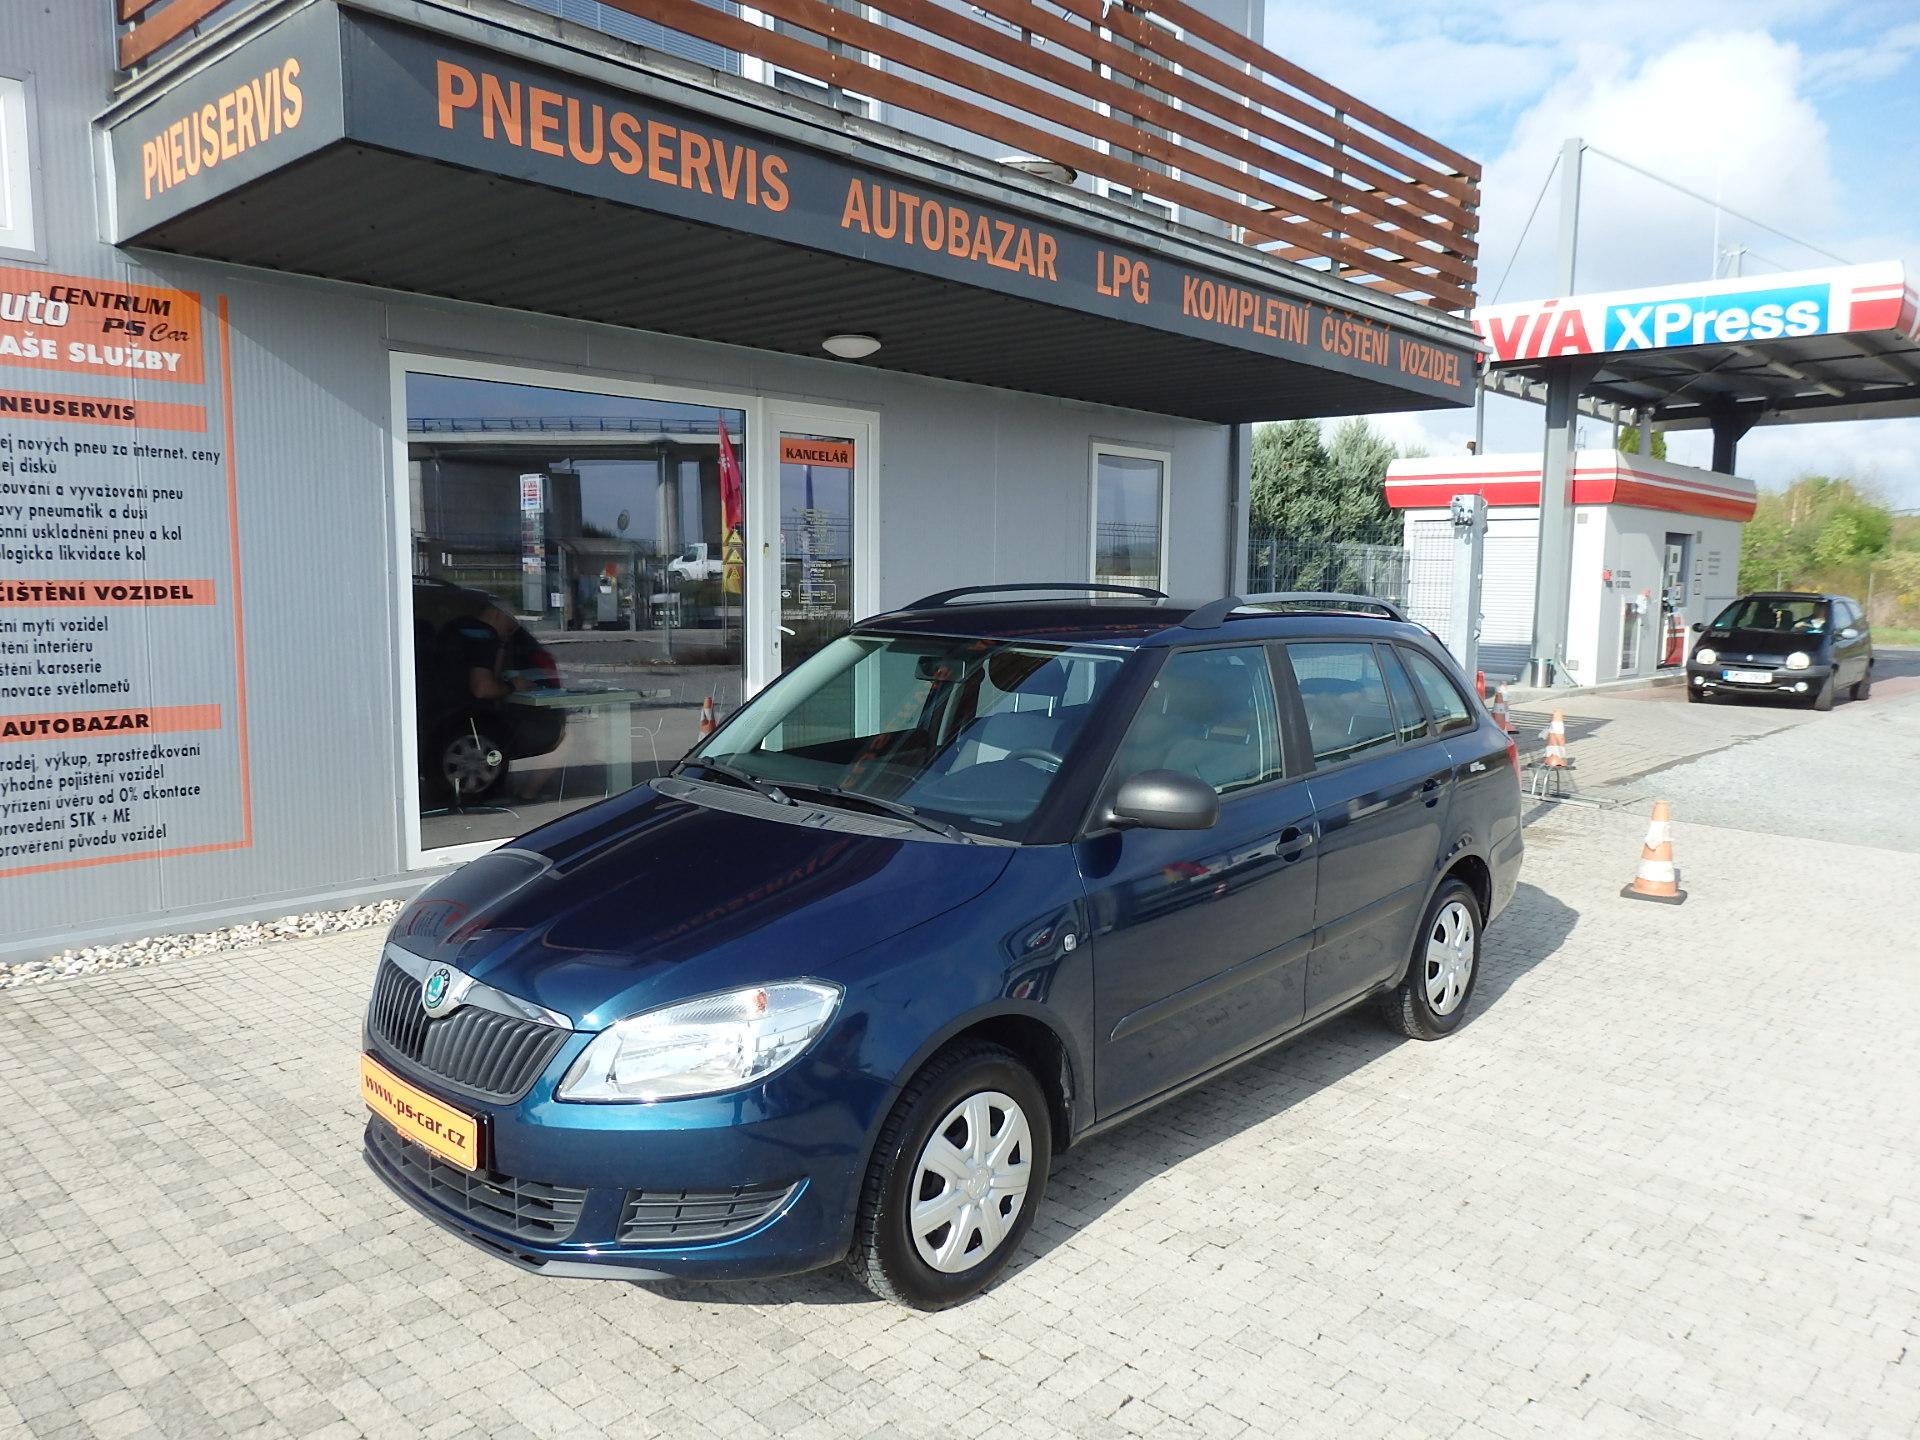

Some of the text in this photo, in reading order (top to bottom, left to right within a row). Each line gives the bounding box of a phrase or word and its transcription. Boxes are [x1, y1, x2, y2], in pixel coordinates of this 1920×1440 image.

[143, 57, 303, 201] PNEUSERVIS
[436, 59, 1462, 388] PNEUSERVIS AUTOBAZAR LPG KOMPLETNÍ ČIŠTĚNÍ VOZIDEL
[50, 286, 171, 316] CENTRUM
[102, 318, 191, 342] PS Car
[1471, 300, 1820, 360] VIA XPress
[0, 330, 181, 372] AŠE SLUŽBY
[0, 396, 136, 420] NEUSERVIS
[18, 436, 69, 455] nových
[74, 442, 107, 457] pneu
[112, 445, 128, 456] za
[133, 441, 188, 460] internet.
[191, 450, 221, 466] ceny
[785, 447, 848, 463] KANCELÁŘ
[56, 485, 64, 496] a
[70, 484, 148, 501] vyvažování
[152, 488, 184, 503] pneu
[29, 503, 103, 520] pneumatik
[109, 508, 117, 519] a
[33, 523, 108, 540] uskladnění
[113, 529, 145, 544] pneu
[149, 530, 157, 540] a
[162, 525, 182, 541] kol
[0, 544, 146, 564] logická likvidace kol
[93, 585, 194, 601] VOZIDEL
[22, 618, 55, 636] mytí
[61, 616, 109, 632] vozidel
[33, 638, 93, 654] interiéru
[37, 659, 102, 676] karoserie
[57, 678, 130, 696] světlometů
[2, 713, 150, 737] AUTOBAZAR
[96, 743, 201, 768] zprostředkování
[119, 764, 165, 782] vozidel
[98, 788, 114, 804] od
[119, 786, 138, 802] 0%
[143, 785, 200, 801] akontace
[70, 811, 96, 828] STK
[113, 807, 131, 824] ME
[69, 830, 116, 852] původu
[121, 823, 167, 842] vozidel
[365, 1075, 467, 1149] www.ps-car.cz
